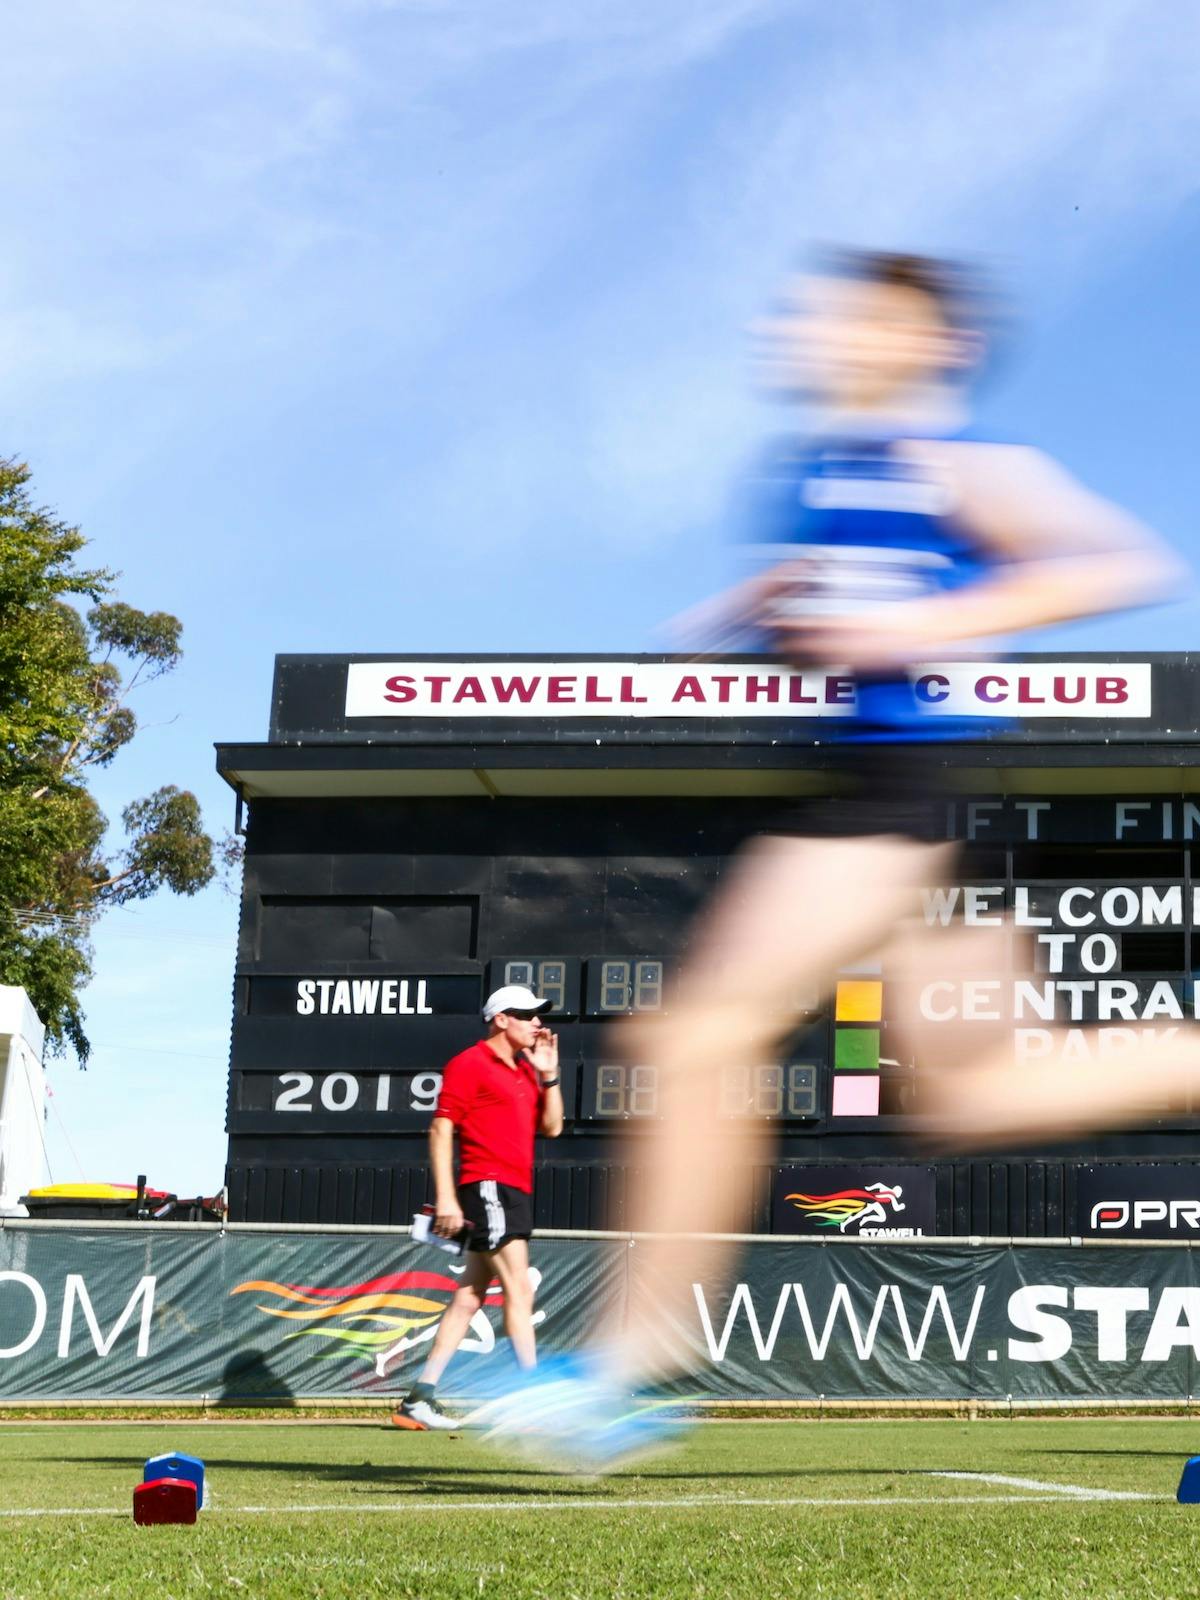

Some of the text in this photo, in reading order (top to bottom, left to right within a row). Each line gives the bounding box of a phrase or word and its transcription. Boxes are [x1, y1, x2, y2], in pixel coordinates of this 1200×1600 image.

[384, 675, 1130, 704] STAWELL ATHLEC CLUB
[944, 802, 1052, 841] IFT
[1037, 933, 1118, 974] TO
[296, 979, 433, 1015] STAWELL
[274, 1071, 443, 1112] 2019
[858, 1227, 925, 1238] STAWELL
